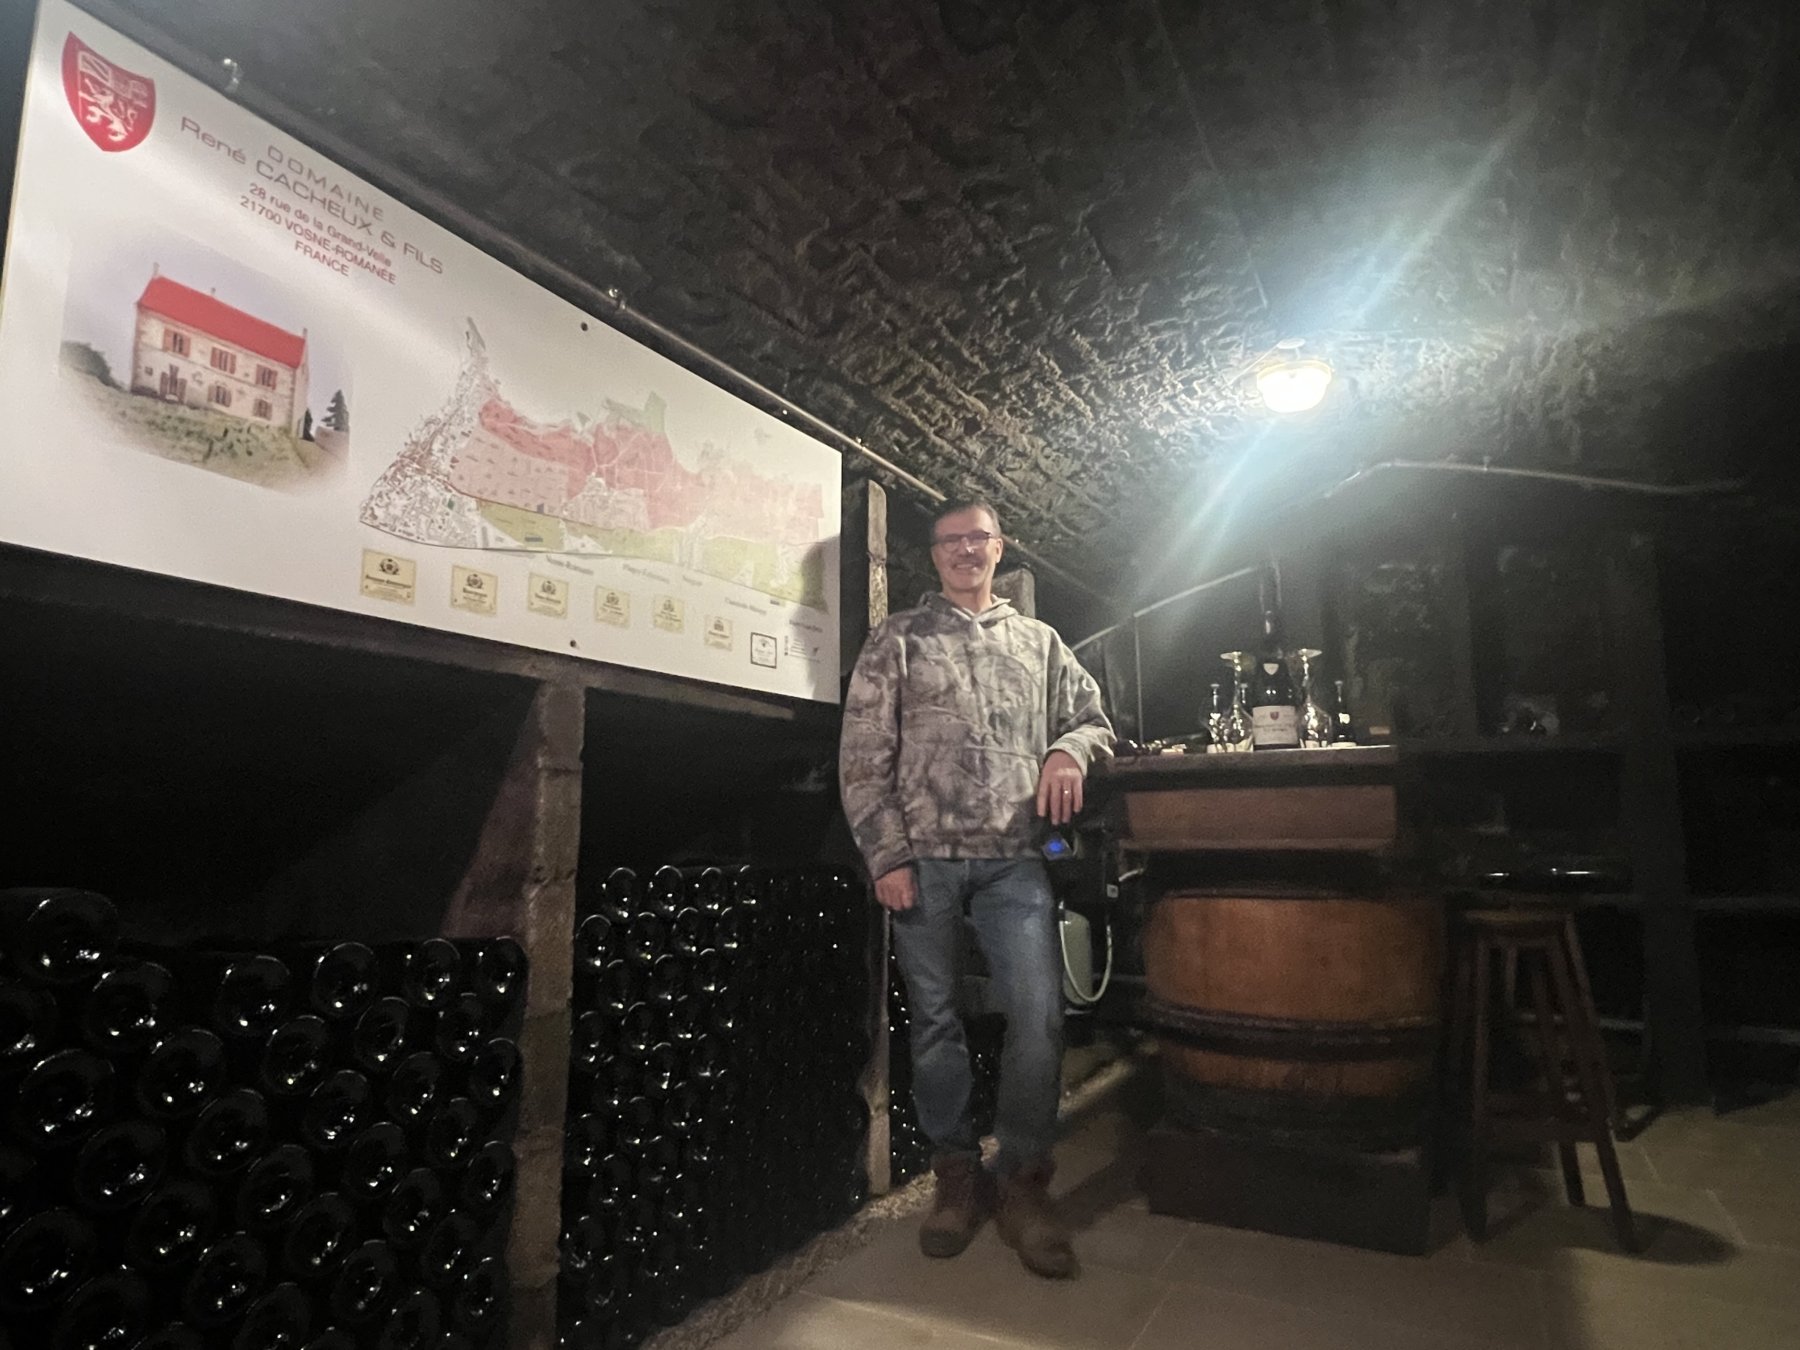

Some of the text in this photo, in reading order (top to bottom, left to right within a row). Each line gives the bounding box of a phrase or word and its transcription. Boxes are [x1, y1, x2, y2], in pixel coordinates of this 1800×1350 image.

[181, 116, 443, 275] René CACHEUX & FILS
[249, 183, 266, 200] 28
[270, 195, 291, 214] rue
[295, 208, 310, 224] de
[313, 216, 324, 231] la
[268, 145, 384, 222] DOMAINE
[240, 195, 397, 286] 21700 VOSNE-ROMANÉE
[294, 240, 351, 277] FRANCE
